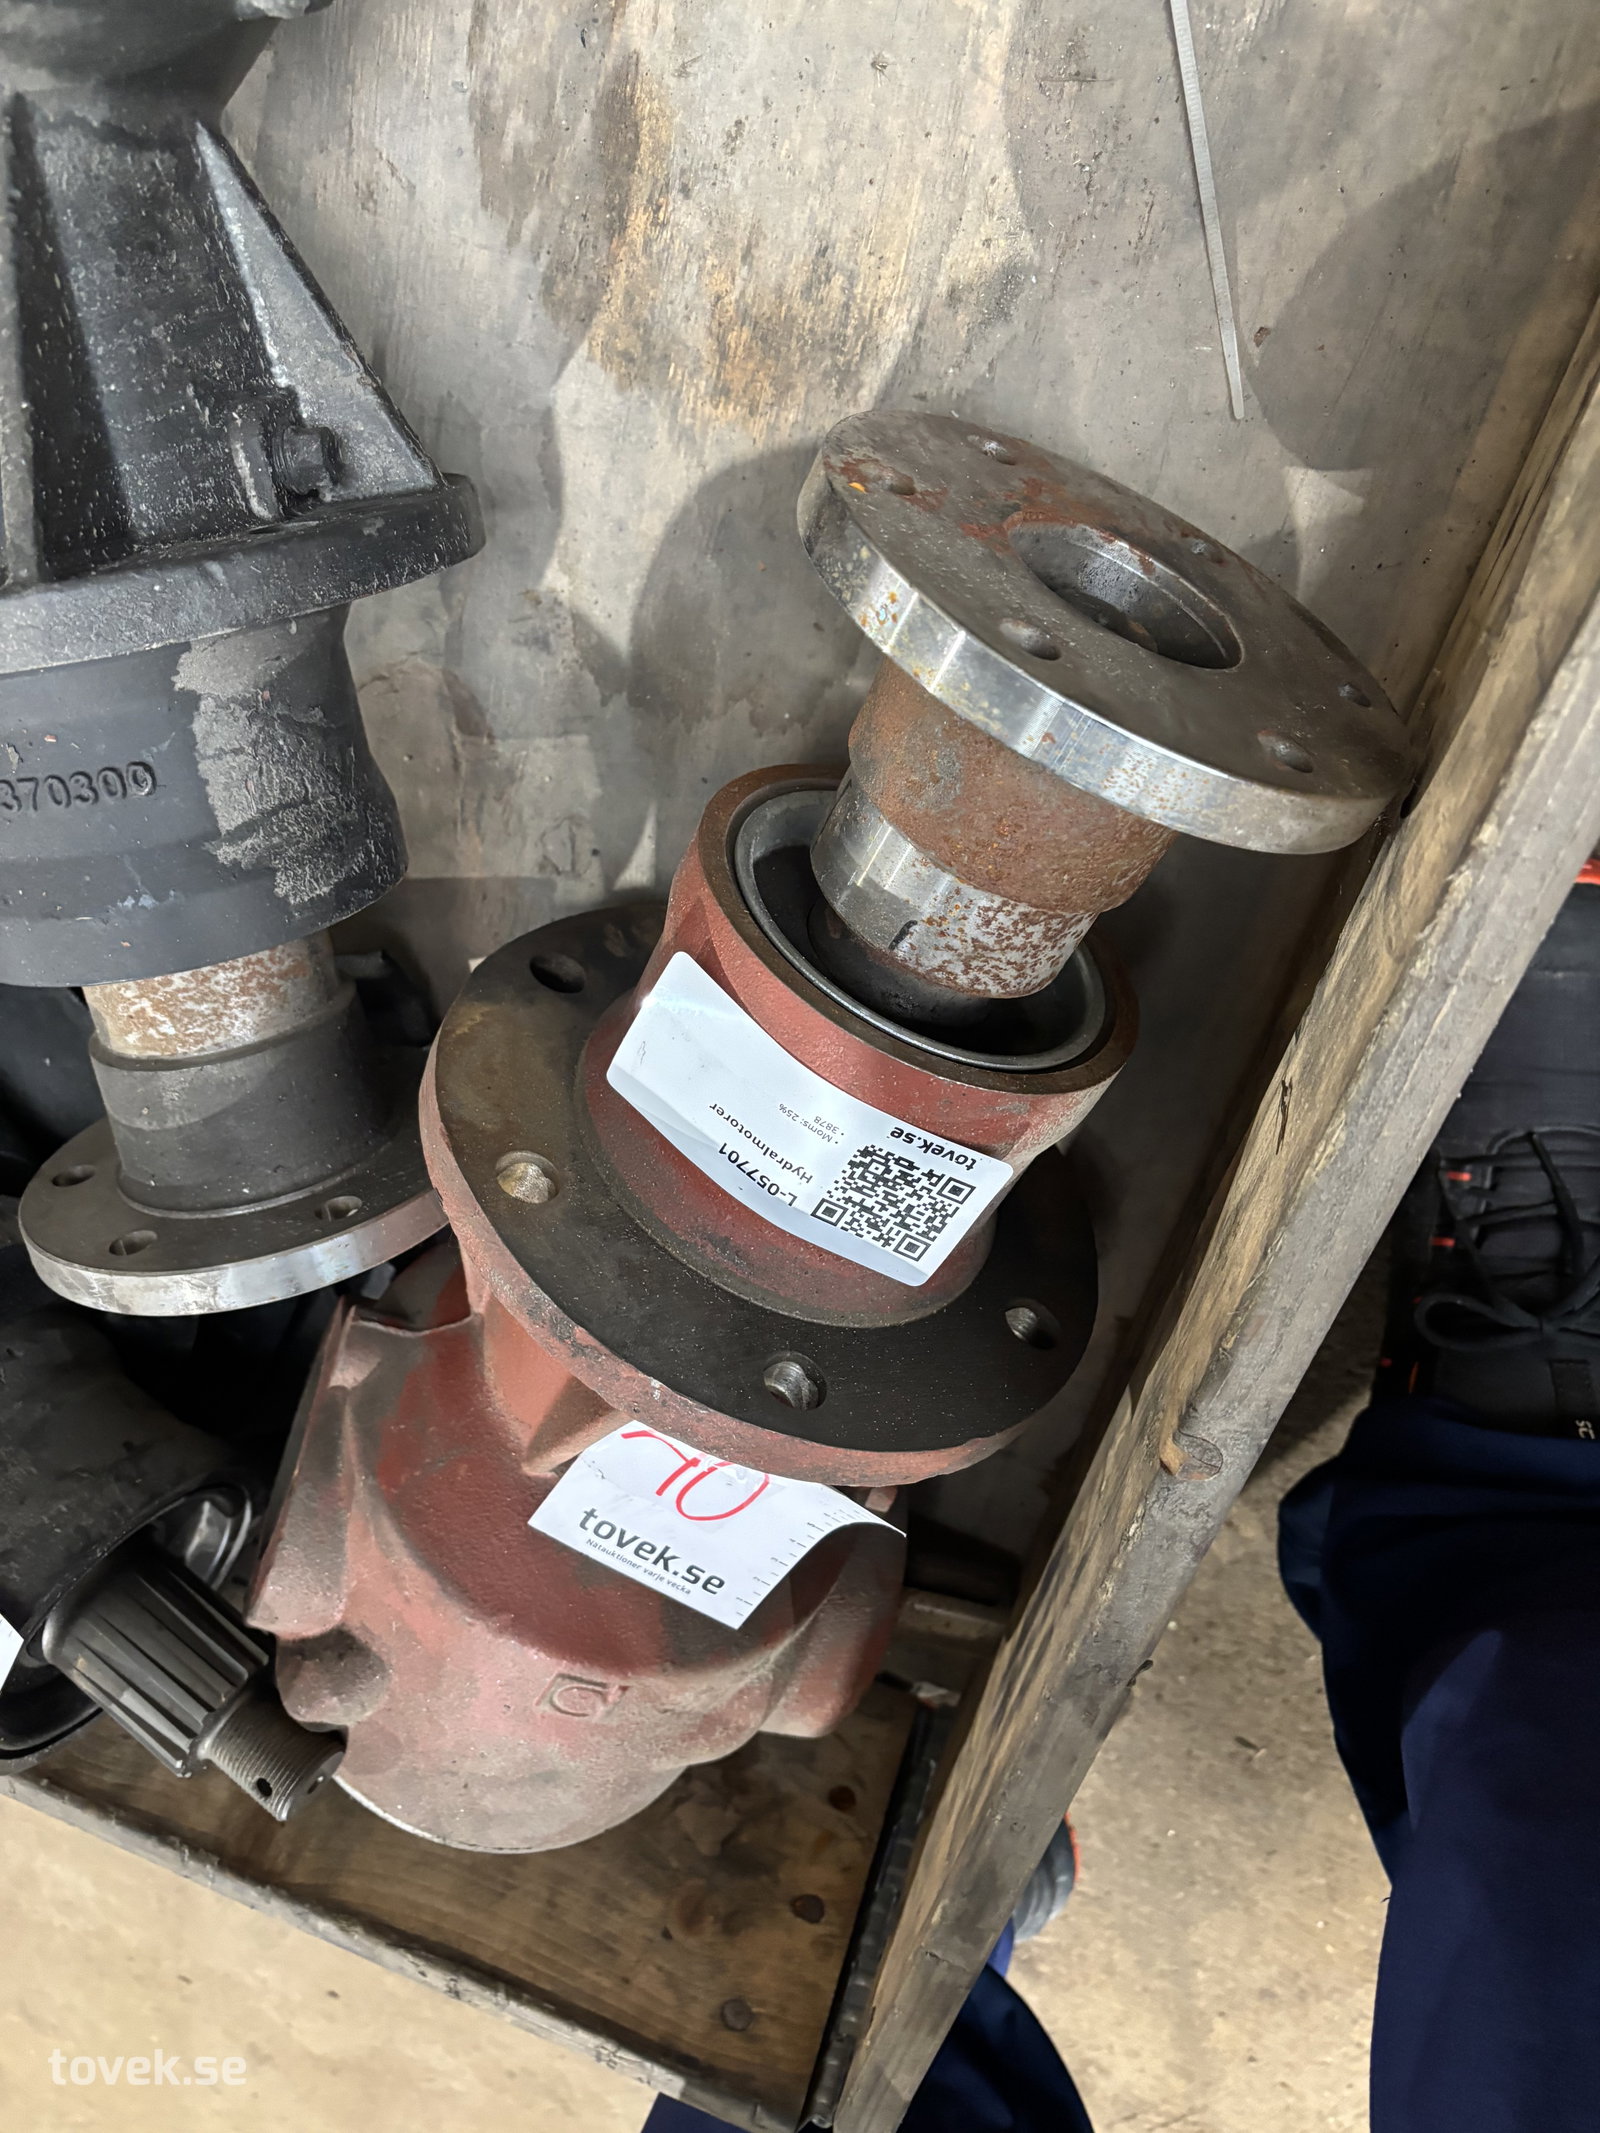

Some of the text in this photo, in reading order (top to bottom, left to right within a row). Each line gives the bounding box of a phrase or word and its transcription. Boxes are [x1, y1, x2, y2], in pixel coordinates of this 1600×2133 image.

[709, 1102, 814, 1185] Hydralmotorer
[779, 1103, 833, 1143] Moms: 25%
[813, 1115, 840, 1135] 3878
[889, 1126, 978, 1172] tovek.se
[718, 1142, 798, 1208] L-057701
[578, 1507, 726, 1596] tovek.se
[667, 1581, 692, 1595] vecka
